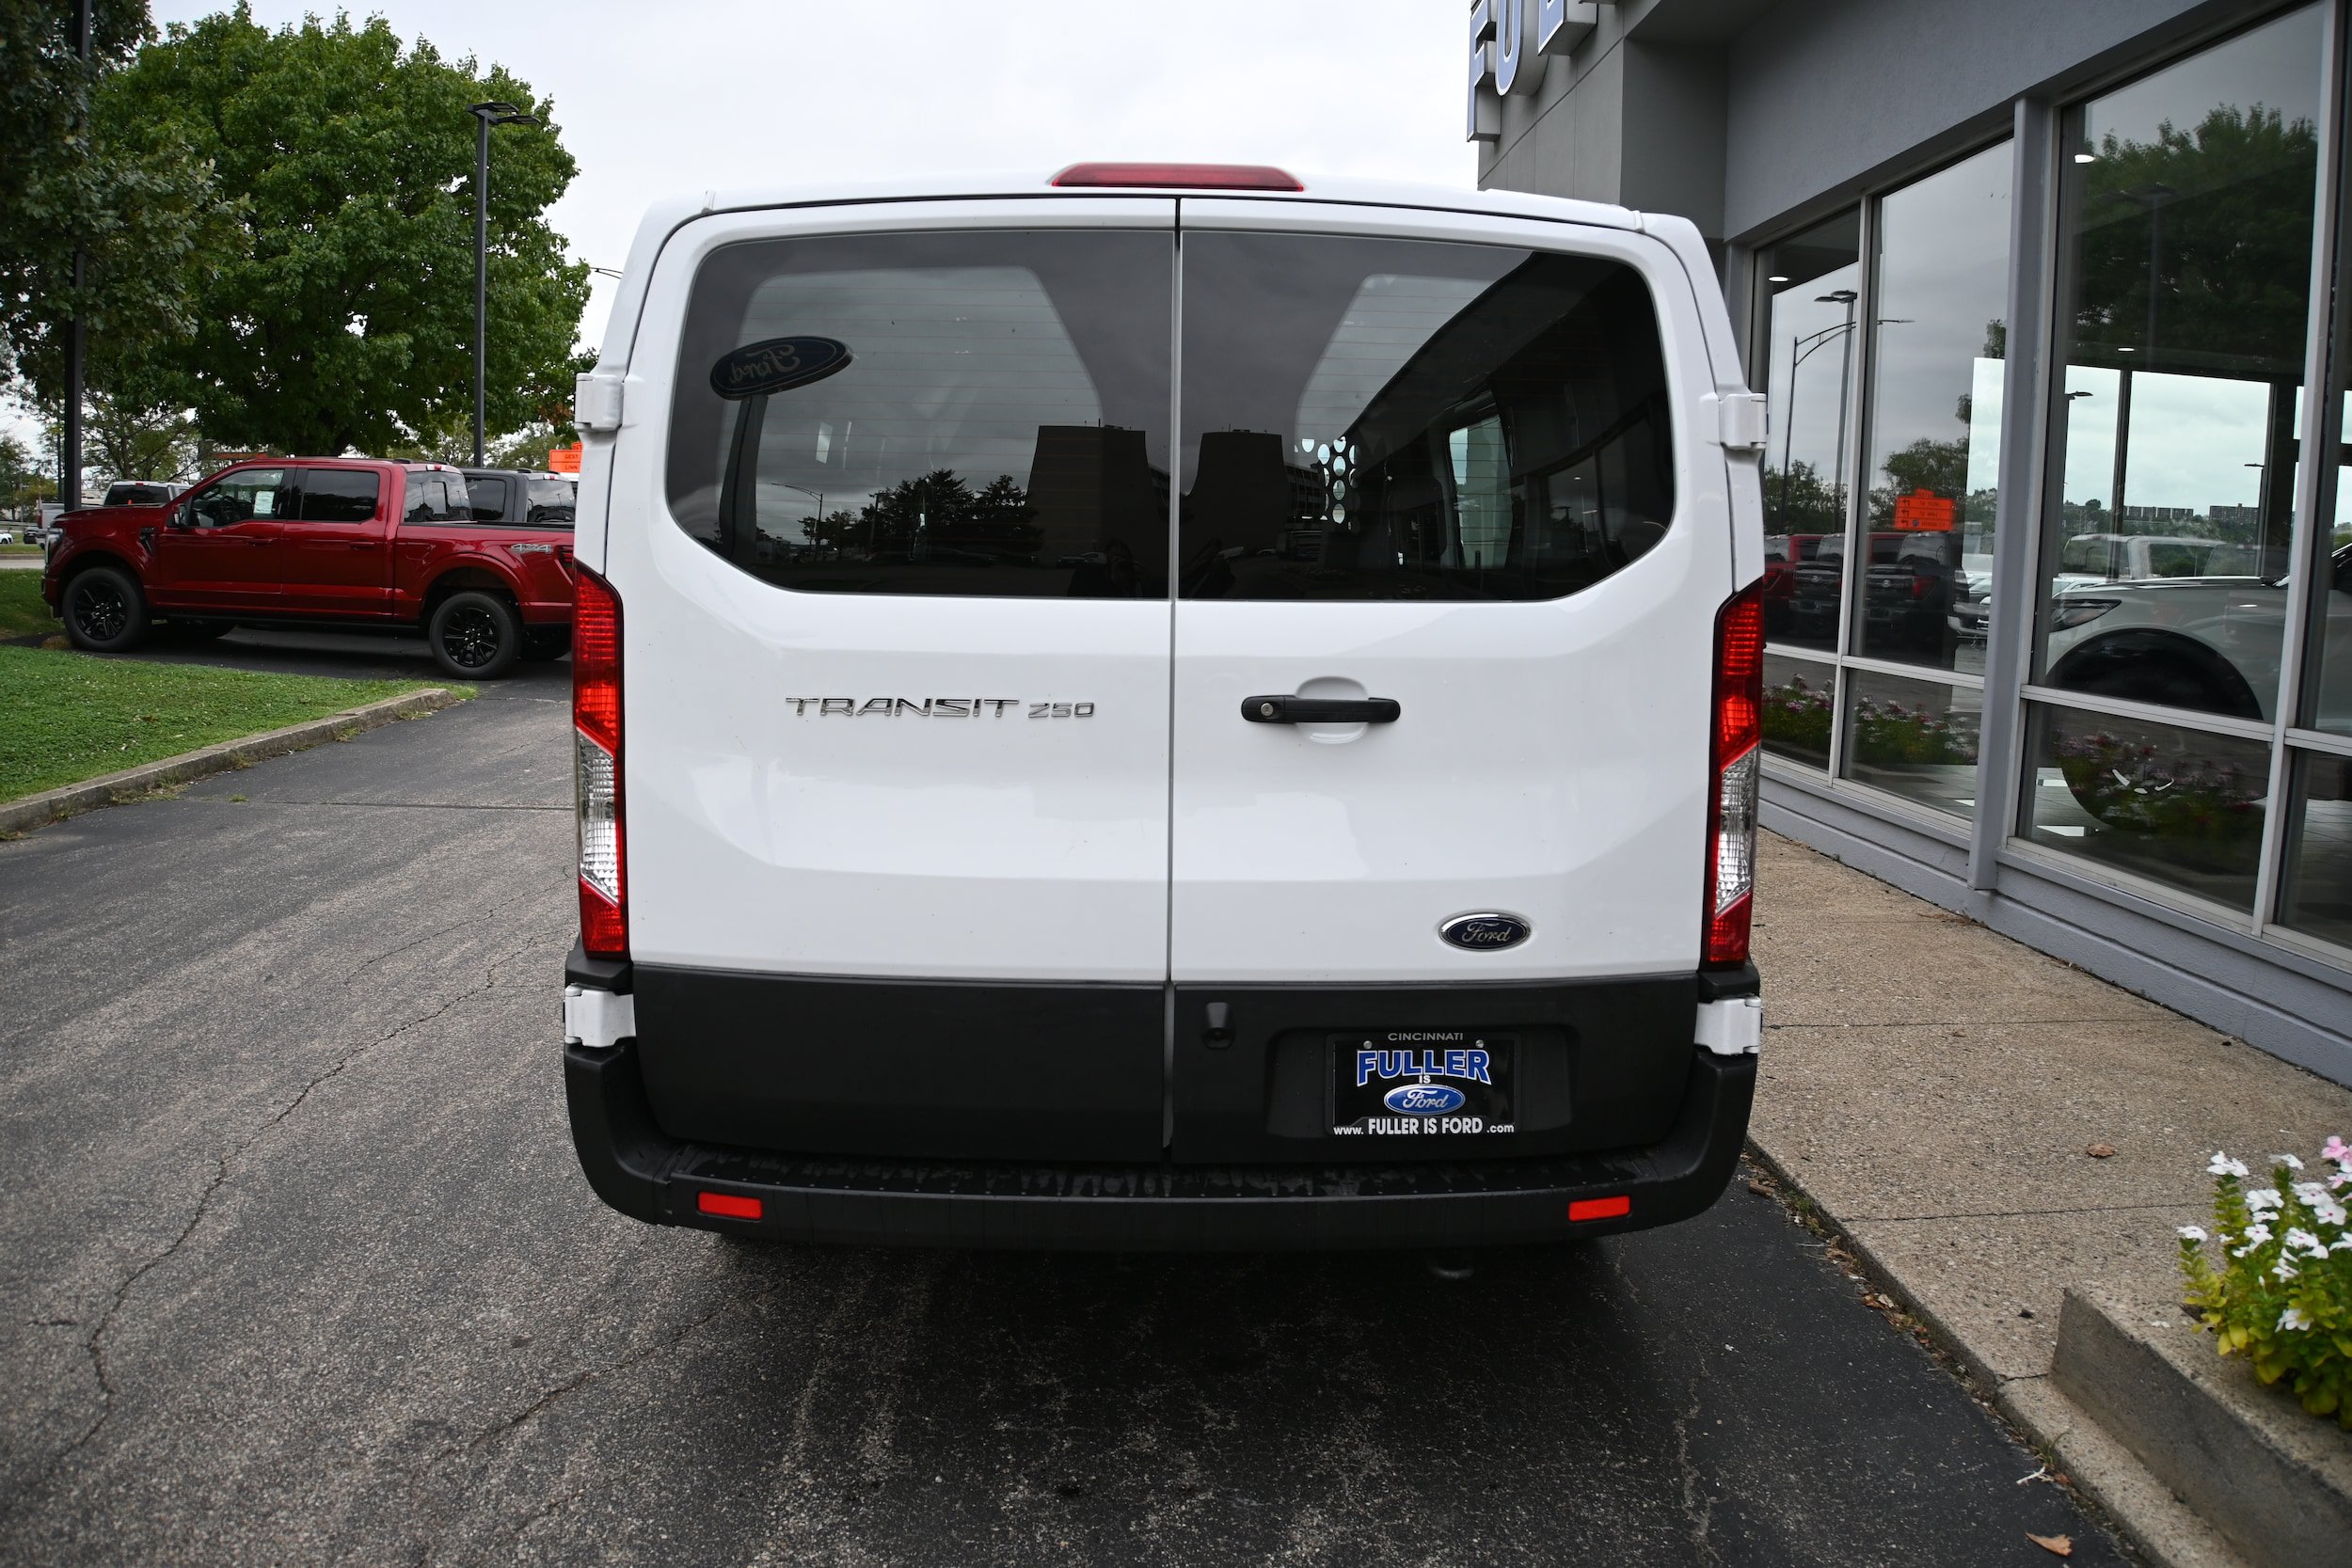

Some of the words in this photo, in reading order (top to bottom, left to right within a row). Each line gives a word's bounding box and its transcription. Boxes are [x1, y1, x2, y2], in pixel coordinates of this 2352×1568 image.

[785, 697, 1020, 717] TRANSIT
[1027, 702, 1094, 719] 250
[1461, 922, 1512, 942] Ford
[1387, 1032, 1464, 1041] CINCINNATI
[1357, 1049, 1492, 1086] FULLER
[1419, 1074, 1431, 1085] IS
[1402, 1089, 1450, 1109] Ford
[1333, 1126, 1364, 1135] www.
[1368, 1117, 1419, 1134] FULLER
[1423, 1117, 1436, 1134] IS
[1441, 1117, 1483, 1134] FORD
[1486, 1123, 1515, 1133] .com
